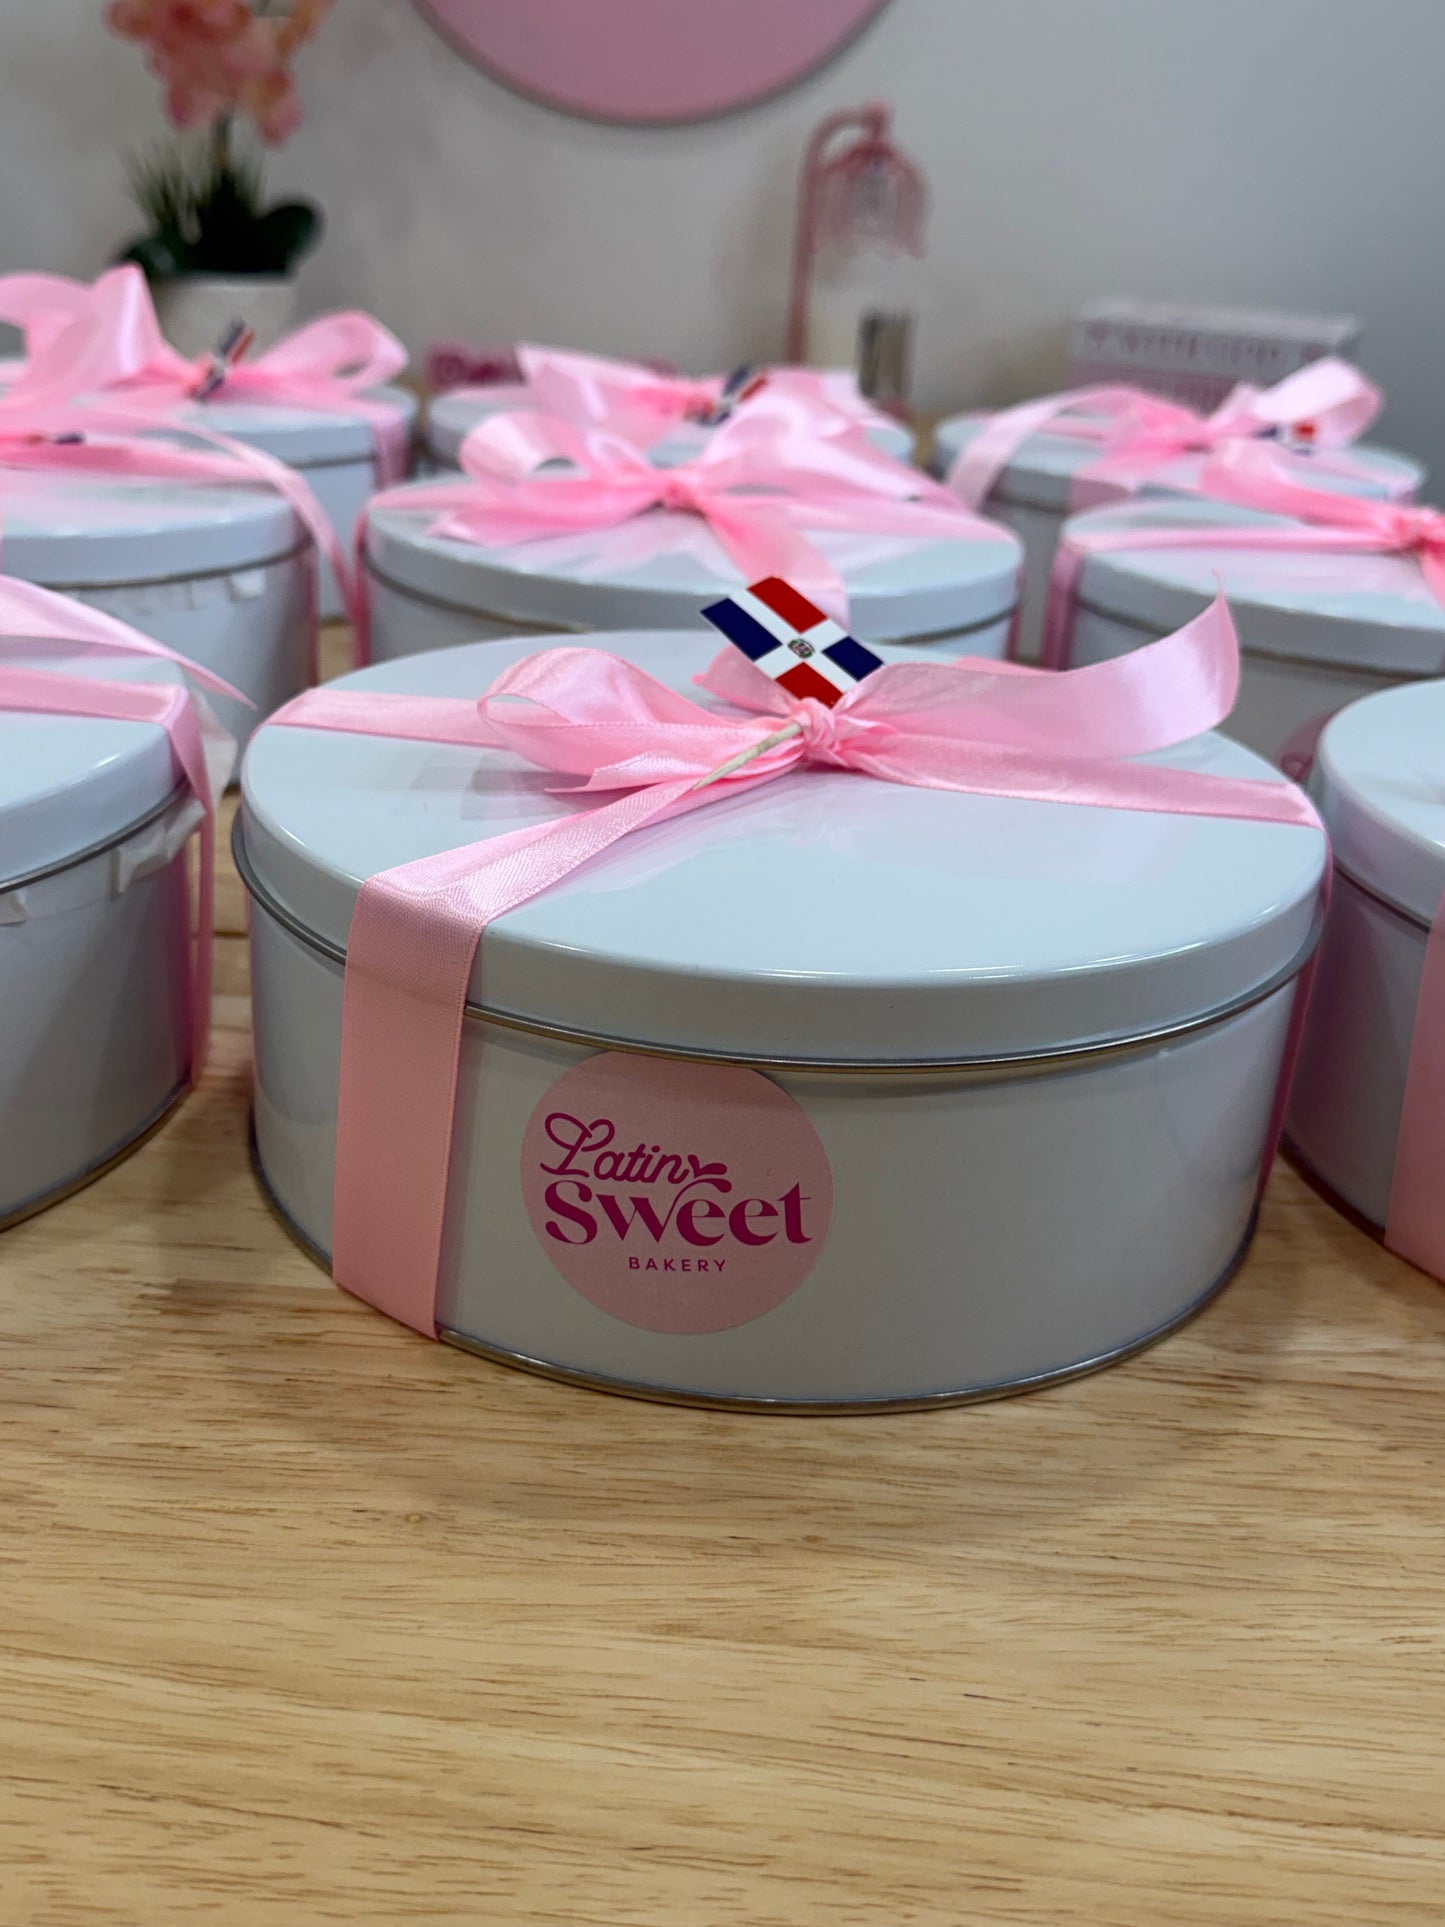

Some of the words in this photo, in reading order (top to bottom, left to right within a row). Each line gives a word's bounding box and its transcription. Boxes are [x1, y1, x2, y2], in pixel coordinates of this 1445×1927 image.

[539, 1112, 690, 1184] Latin
[544, 1178, 813, 1246] Sweet
[628, 1256, 726, 1272] BAKERY
